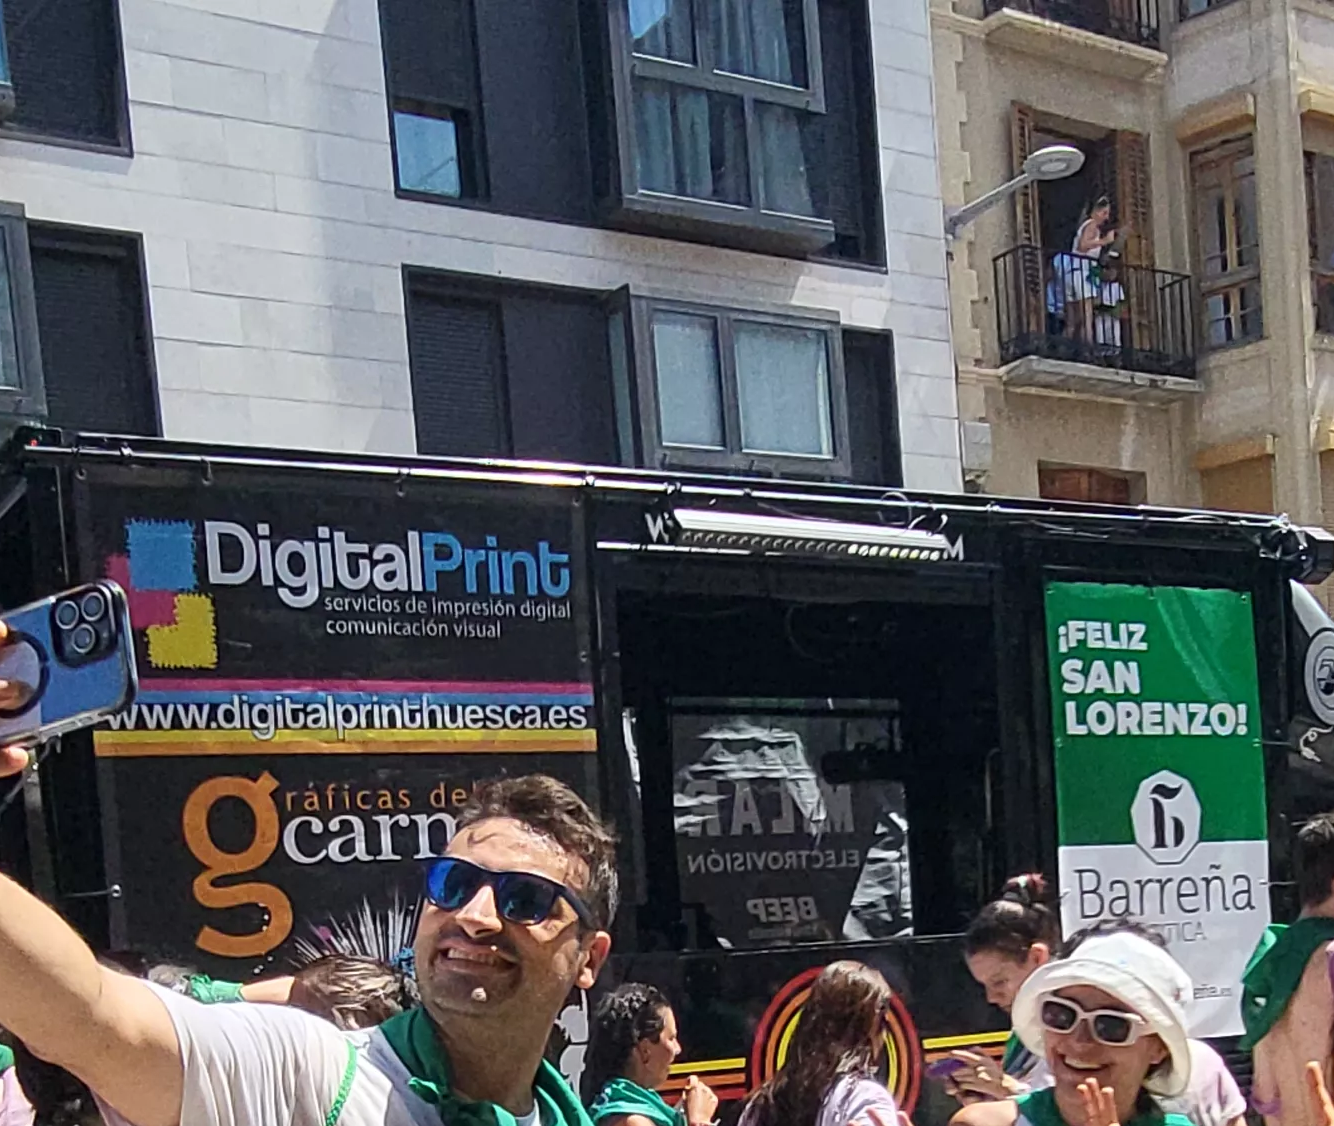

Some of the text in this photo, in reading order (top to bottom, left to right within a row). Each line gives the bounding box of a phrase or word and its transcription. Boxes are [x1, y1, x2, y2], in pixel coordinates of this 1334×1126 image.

[203, 520, 570, 607] DigitalPrint
[323, 594, 571, 622] servicios de impresión digital
[325, 616, 502, 640] comunicación visual
[1058, 620, 1147, 653] ¡FELIZ
[1061, 659, 1140, 694] SAN
[107, 694, 587, 741] www.digitalprinthuesca.es
[1065, 701, 1248, 737] LORENZO!
[1073, 864, 1255, 919] Barreña
